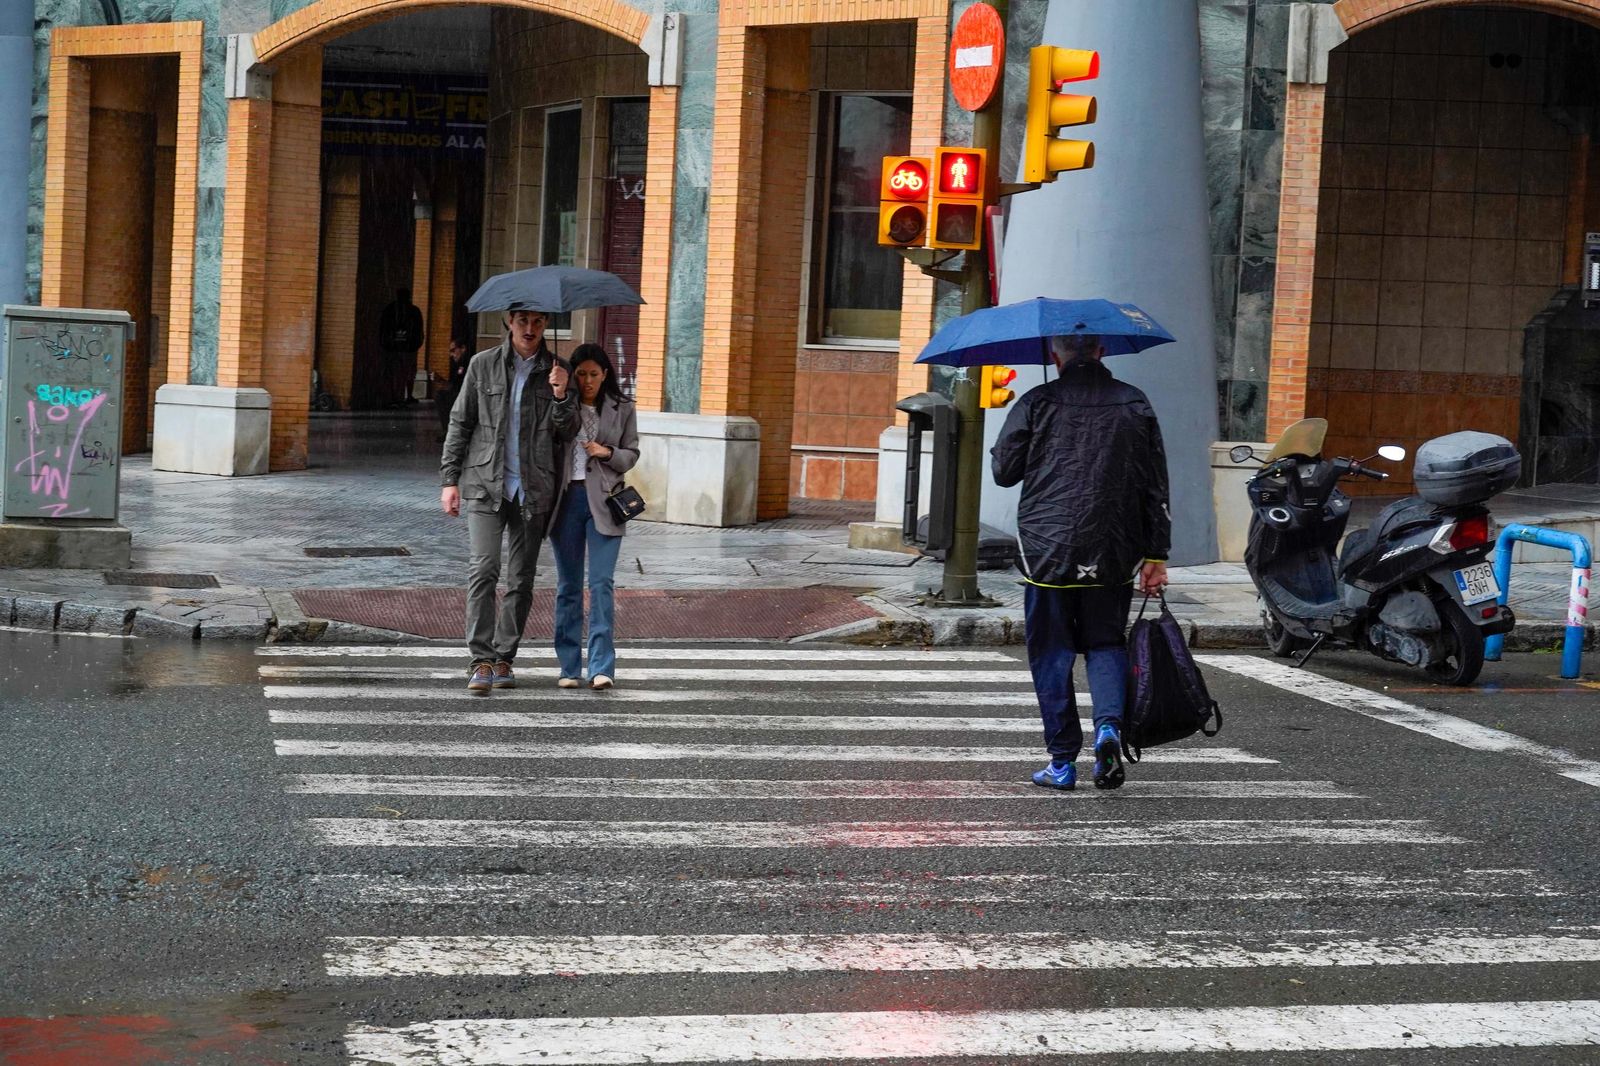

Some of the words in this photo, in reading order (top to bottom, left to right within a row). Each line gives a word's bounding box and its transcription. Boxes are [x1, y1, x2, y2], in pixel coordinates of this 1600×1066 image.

[323, 131, 442, 148] BIENVENIDOS
[445, 134, 470, 149] AL
[1464, 565, 1491, 583] 2236
[1468, 580, 1489, 596] GNH
